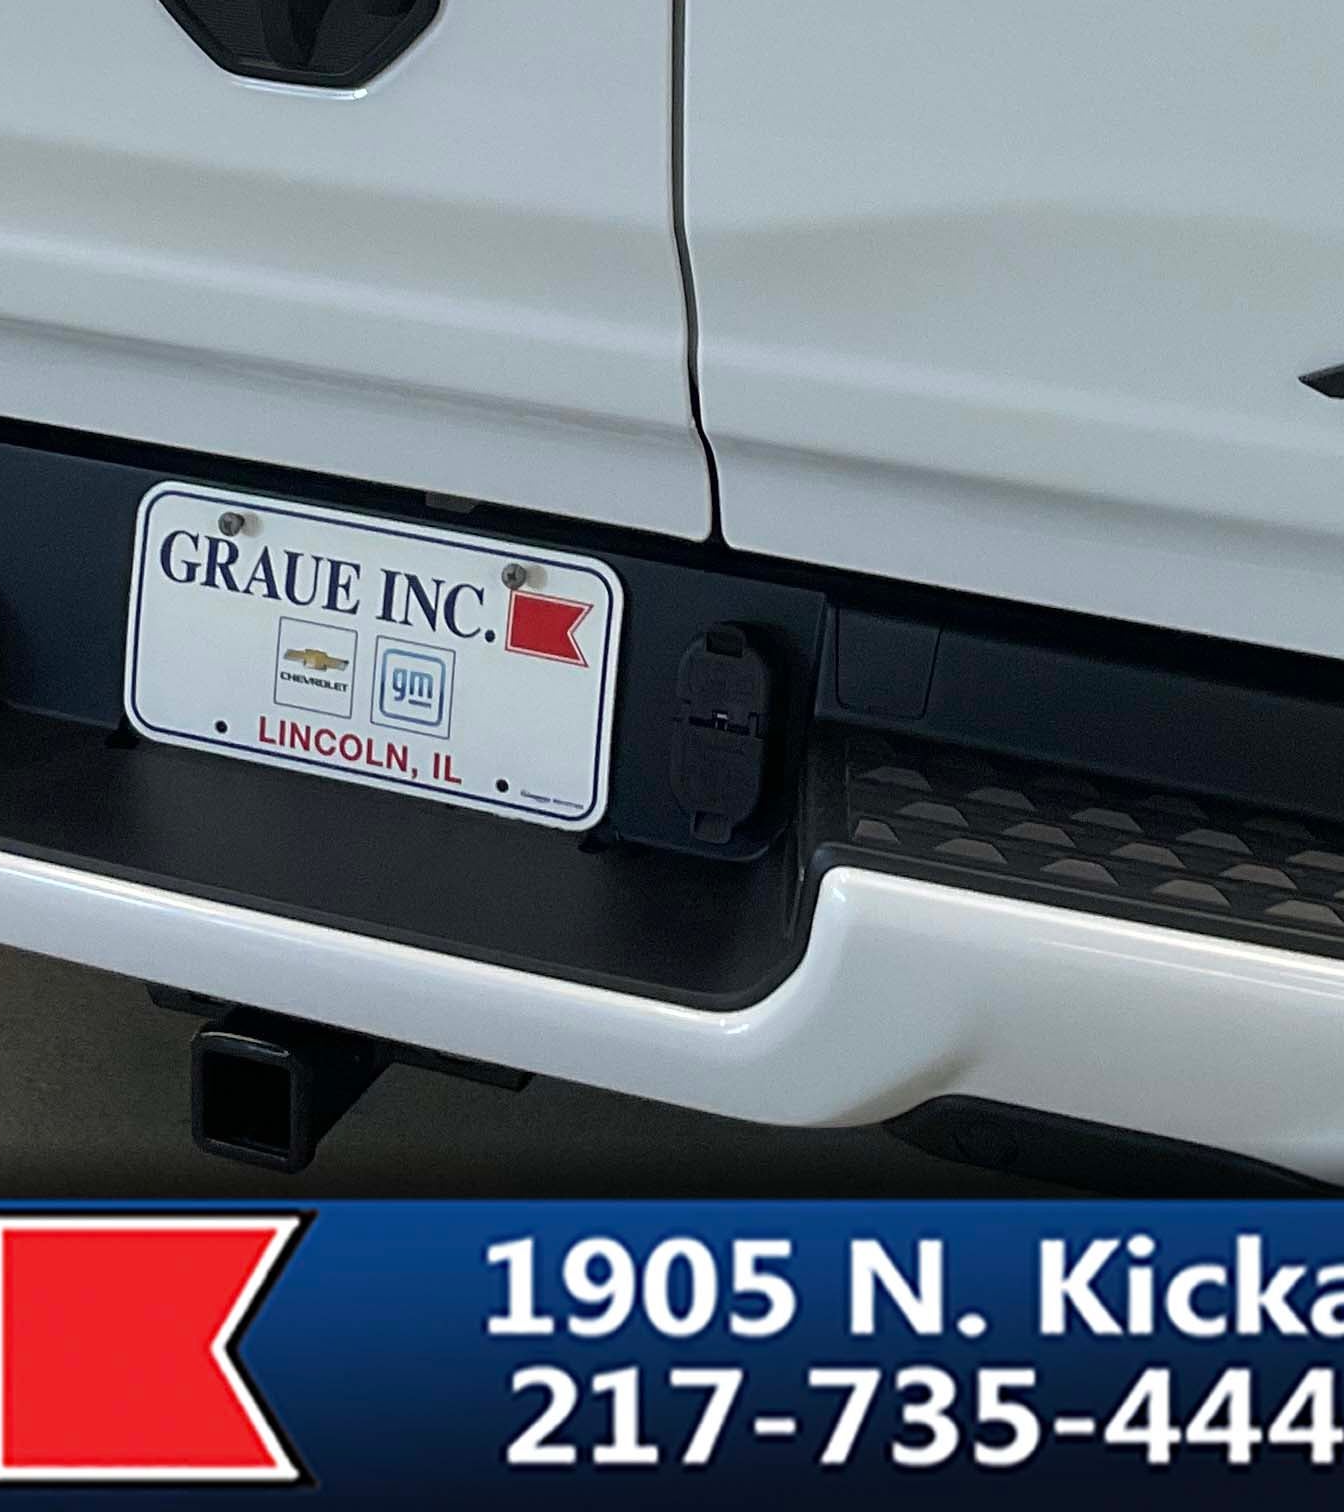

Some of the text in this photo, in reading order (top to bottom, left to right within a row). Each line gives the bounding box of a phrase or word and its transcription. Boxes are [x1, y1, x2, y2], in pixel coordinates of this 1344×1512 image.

[159, 529, 498, 645] GRAUE INC.
[278, 670, 350, 694] CHEVROLET
[392, 666, 435, 709] gm
[257, 715, 463, 786] LINCOLN, IL
